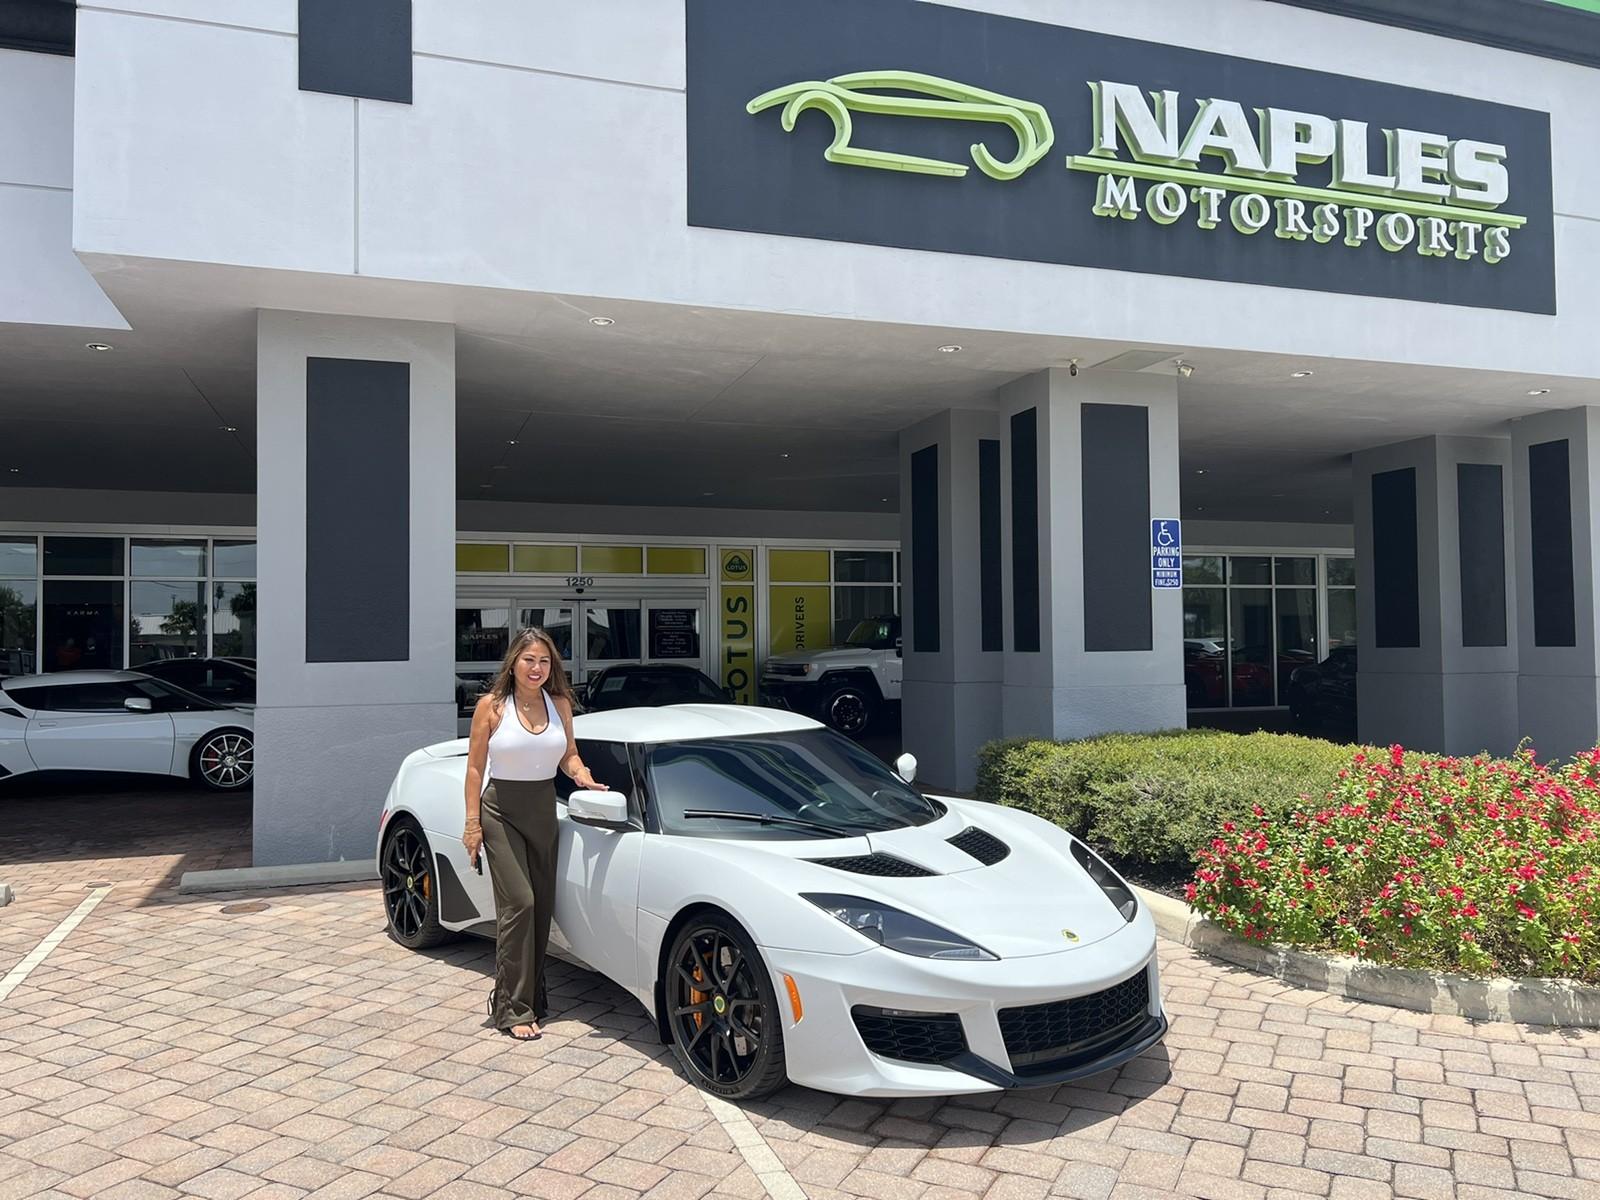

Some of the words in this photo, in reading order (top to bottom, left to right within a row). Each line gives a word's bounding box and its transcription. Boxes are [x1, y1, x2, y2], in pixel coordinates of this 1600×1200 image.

[1087, 80, 1509, 209] NAPLES
[1092, 173, 1511, 264] MOTORSPORTS
[1153, 546, 1180, 557] PARKING
[1158, 558, 1175, 568] ONLY
[565, 576, 593, 587] 1250
